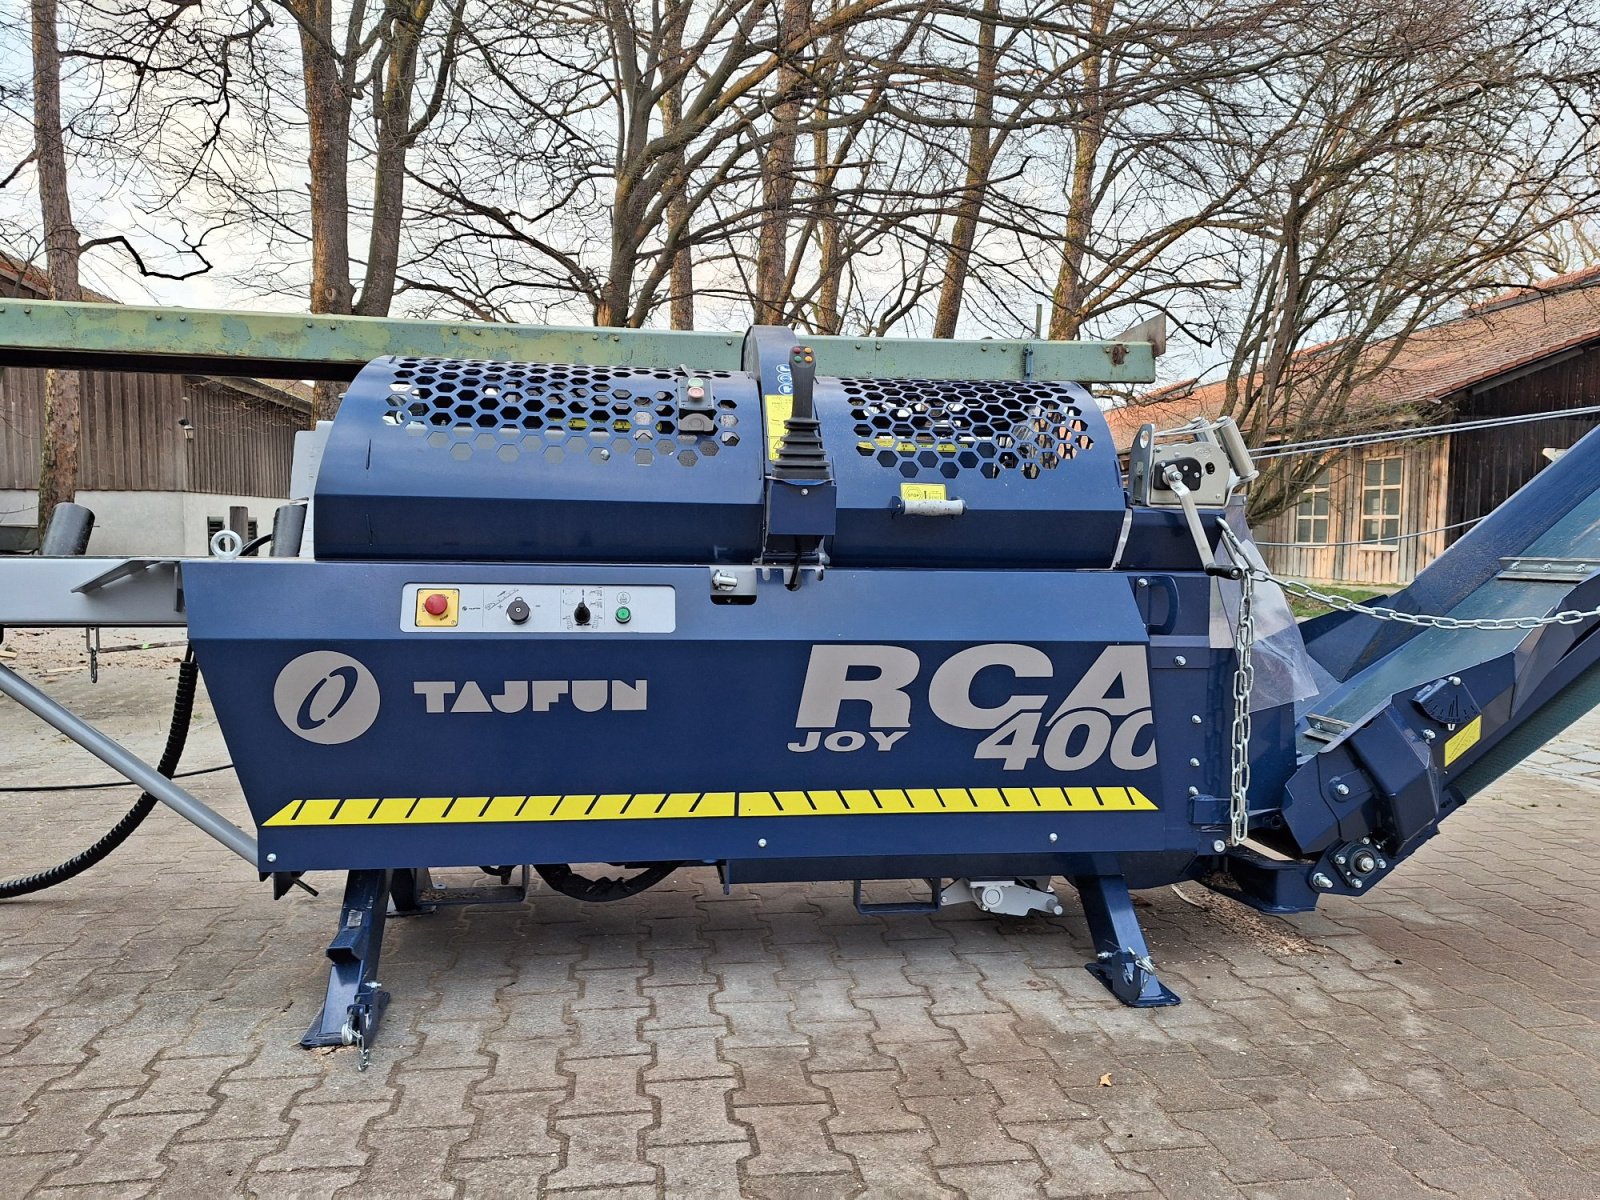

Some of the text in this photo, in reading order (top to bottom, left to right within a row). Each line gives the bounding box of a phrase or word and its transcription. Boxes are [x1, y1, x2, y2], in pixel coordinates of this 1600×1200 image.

[413, 679, 648, 713] TAJFUN
[795, 643, 1152, 730] RCA
[787, 730, 909, 753] JOY
[973, 709, 1158, 772] 400
